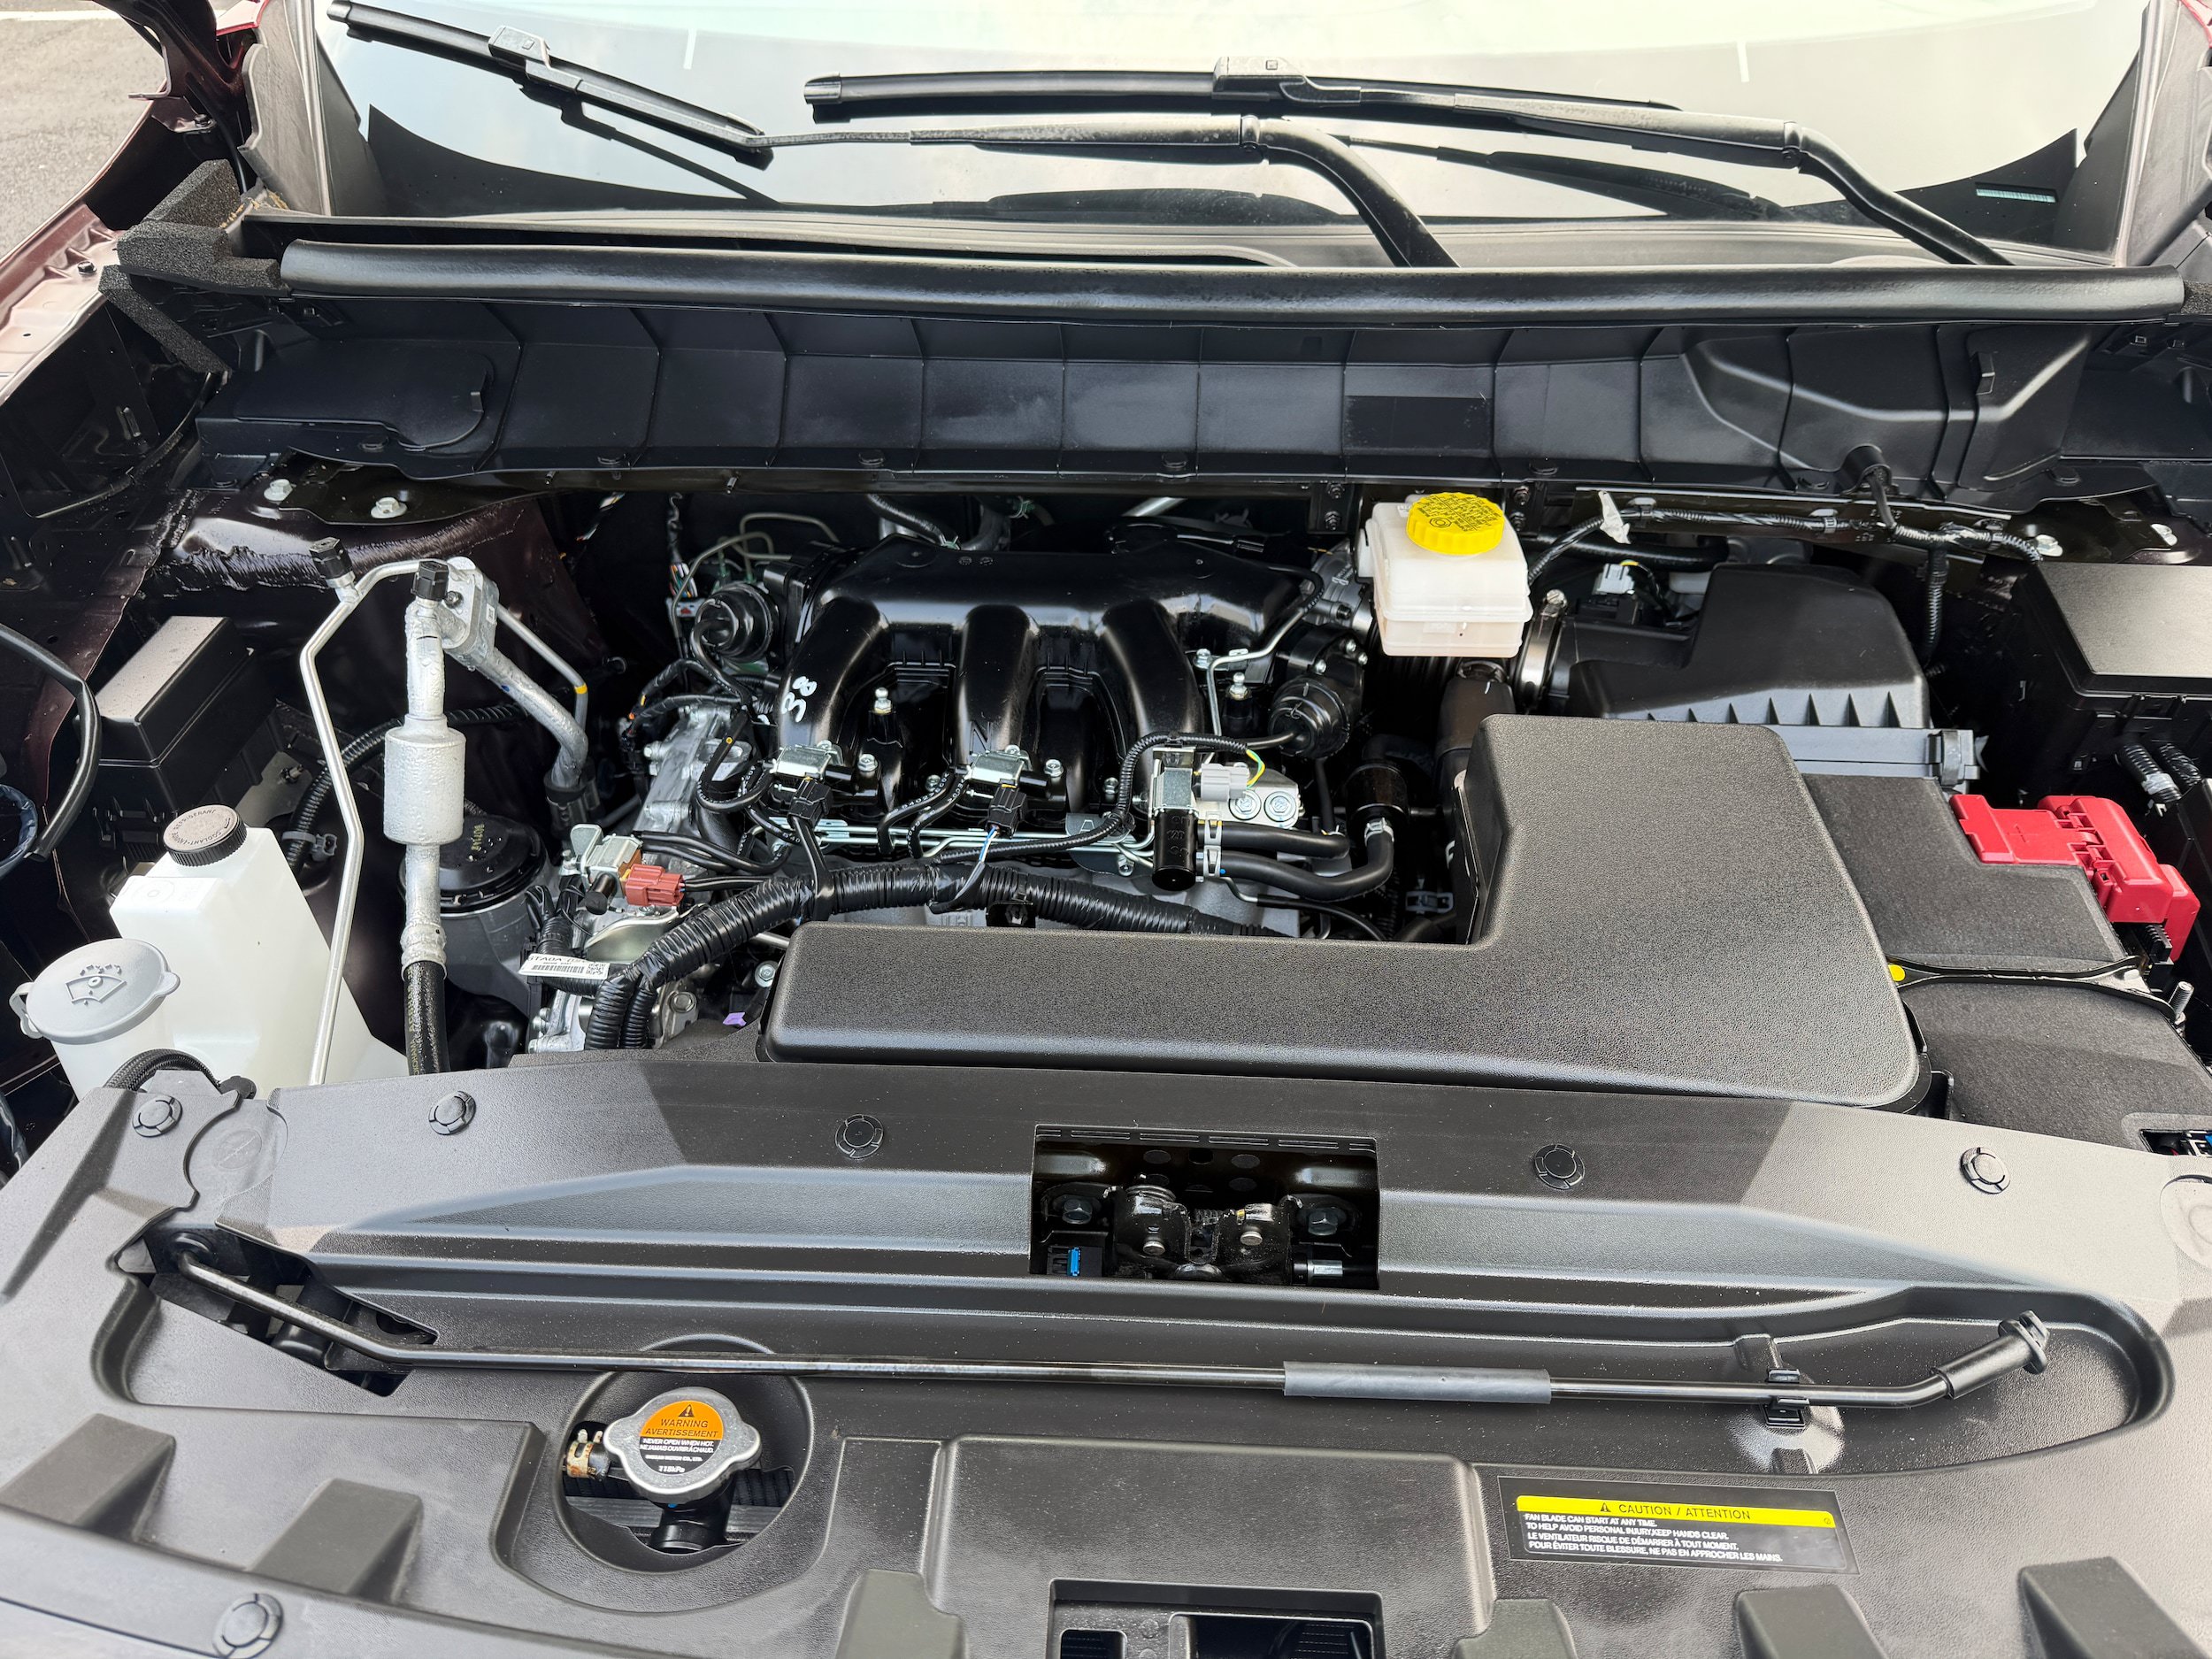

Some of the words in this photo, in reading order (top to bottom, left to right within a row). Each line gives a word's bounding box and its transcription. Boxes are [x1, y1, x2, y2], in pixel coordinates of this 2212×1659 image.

[780, 676, 817, 722] 38
[661, 1419, 708, 1428] WARNING
[646, 1428, 718, 1437] AVERTISSEMENT
[1619, 1504, 1672, 1515] CAUTION
[1686, 1508, 1750, 1520] ATTENTION
[1610, 1517, 1619, 1525] AT
[1637, 1518, 1658, 1527] TIME.
[1584, 1525, 1625, 1534] PERSONAL
[1672, 1530, 1701, 1539] HANDS
[1701, 1531, 1729, 1540] CLEAR.
[1539, 1532, 1588, 1542] VENTILATEUR
[1632, 1536, 1674, 1547] DÉMARRER
[1674, 1538, 1681, 1547] À
[1681, 1540, 1702, 1548] TOUT
[1702, 1541, 1740, 1550] MOMENT.
[1553, 1540, 1579, 1550] ÉVITER
[1580, 1543, 1605, 1552] TOUTE
[1606, 1544, 1648, 1555] BLESSURE,
[1690, 1549, 1740, 1560] APPROCHER
[1740, 1552, 1755, 1561] LES
[1755, 1553, 1784, 1563] MAINS.
